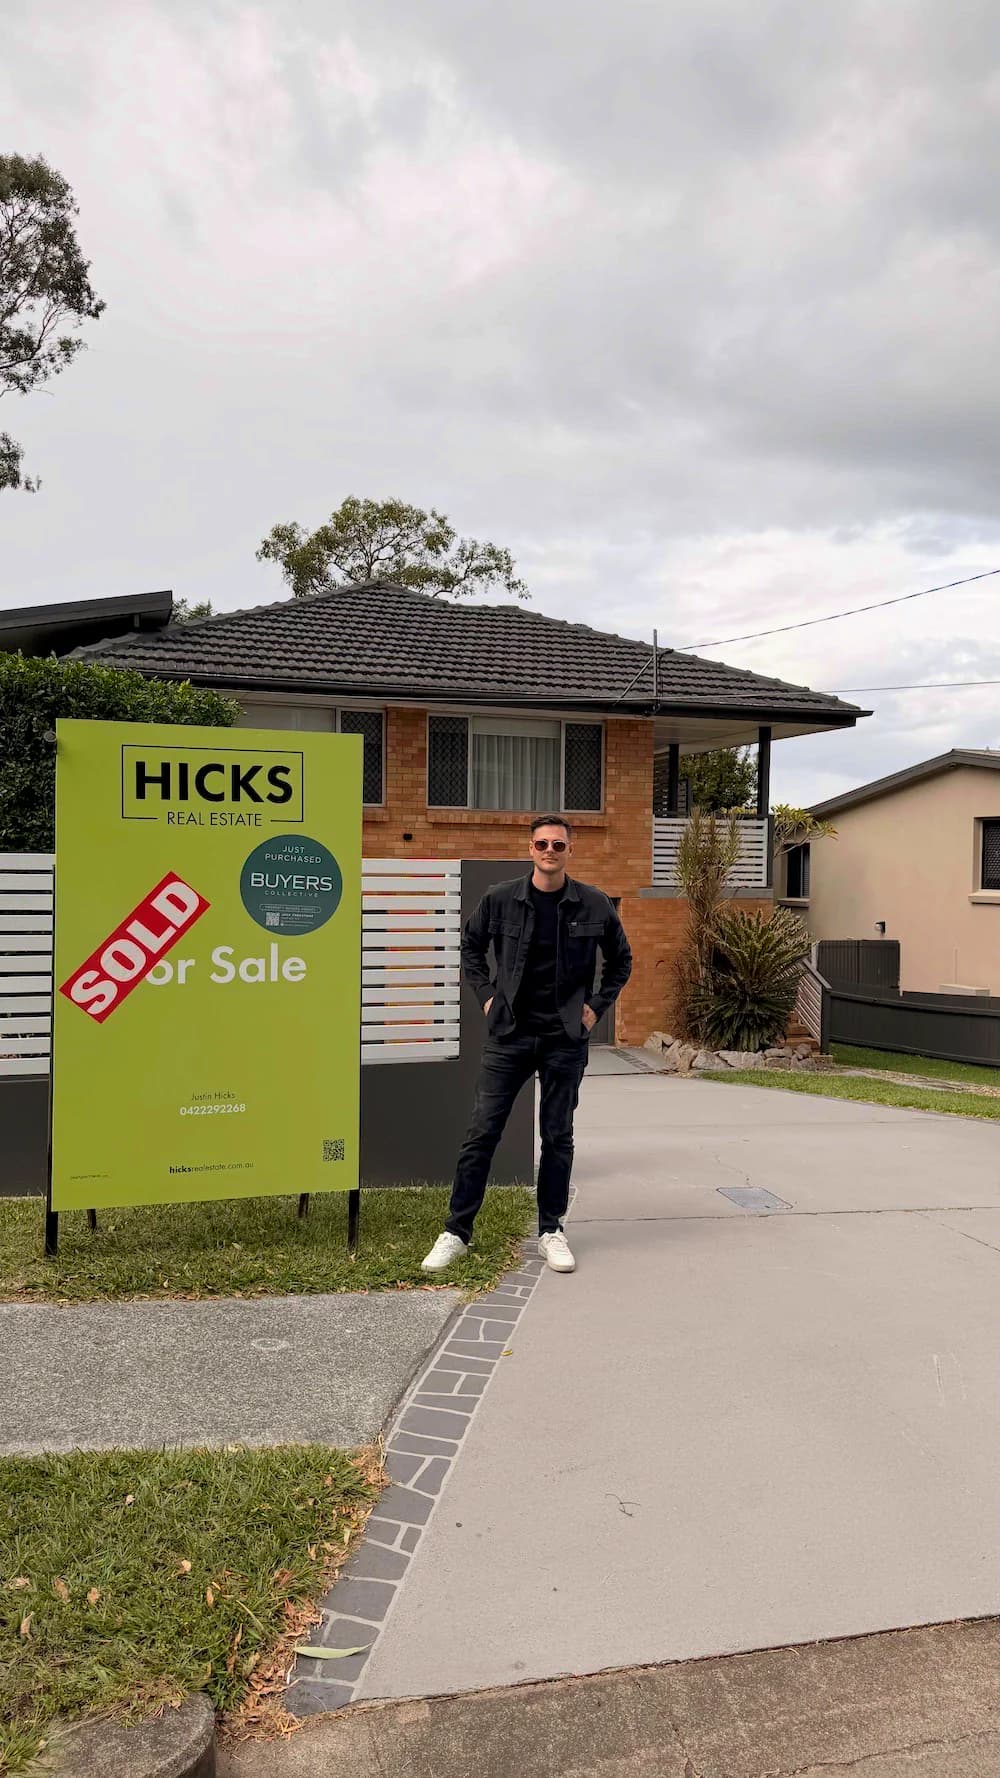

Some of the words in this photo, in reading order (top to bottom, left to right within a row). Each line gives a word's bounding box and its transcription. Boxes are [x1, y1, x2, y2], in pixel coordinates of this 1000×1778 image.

[136, 761, 293, 804] HICKS
[167, 811, 204, 826] REAL
[210, 812, 263, 827] ESTATE
[282, 846, 305, 854] JUST
[265, 853, 322, 864] PURCHASED
[250, 872, 333, 891] BUYERS
[264, 890, 319, 898] COLLECTIVE
[70, 880, 200, 1015] SOLD
[145, 958, 195, 985] or
[210, 943, 307, 984] Sale
[191, 1091, 212, 1101] Justin
[214, 1089, 236, 1100] Hicks
[180, 1103, 246, 1116] 0422292268
[169, 1162, 254, 1174] hicksrealestate.com.au
